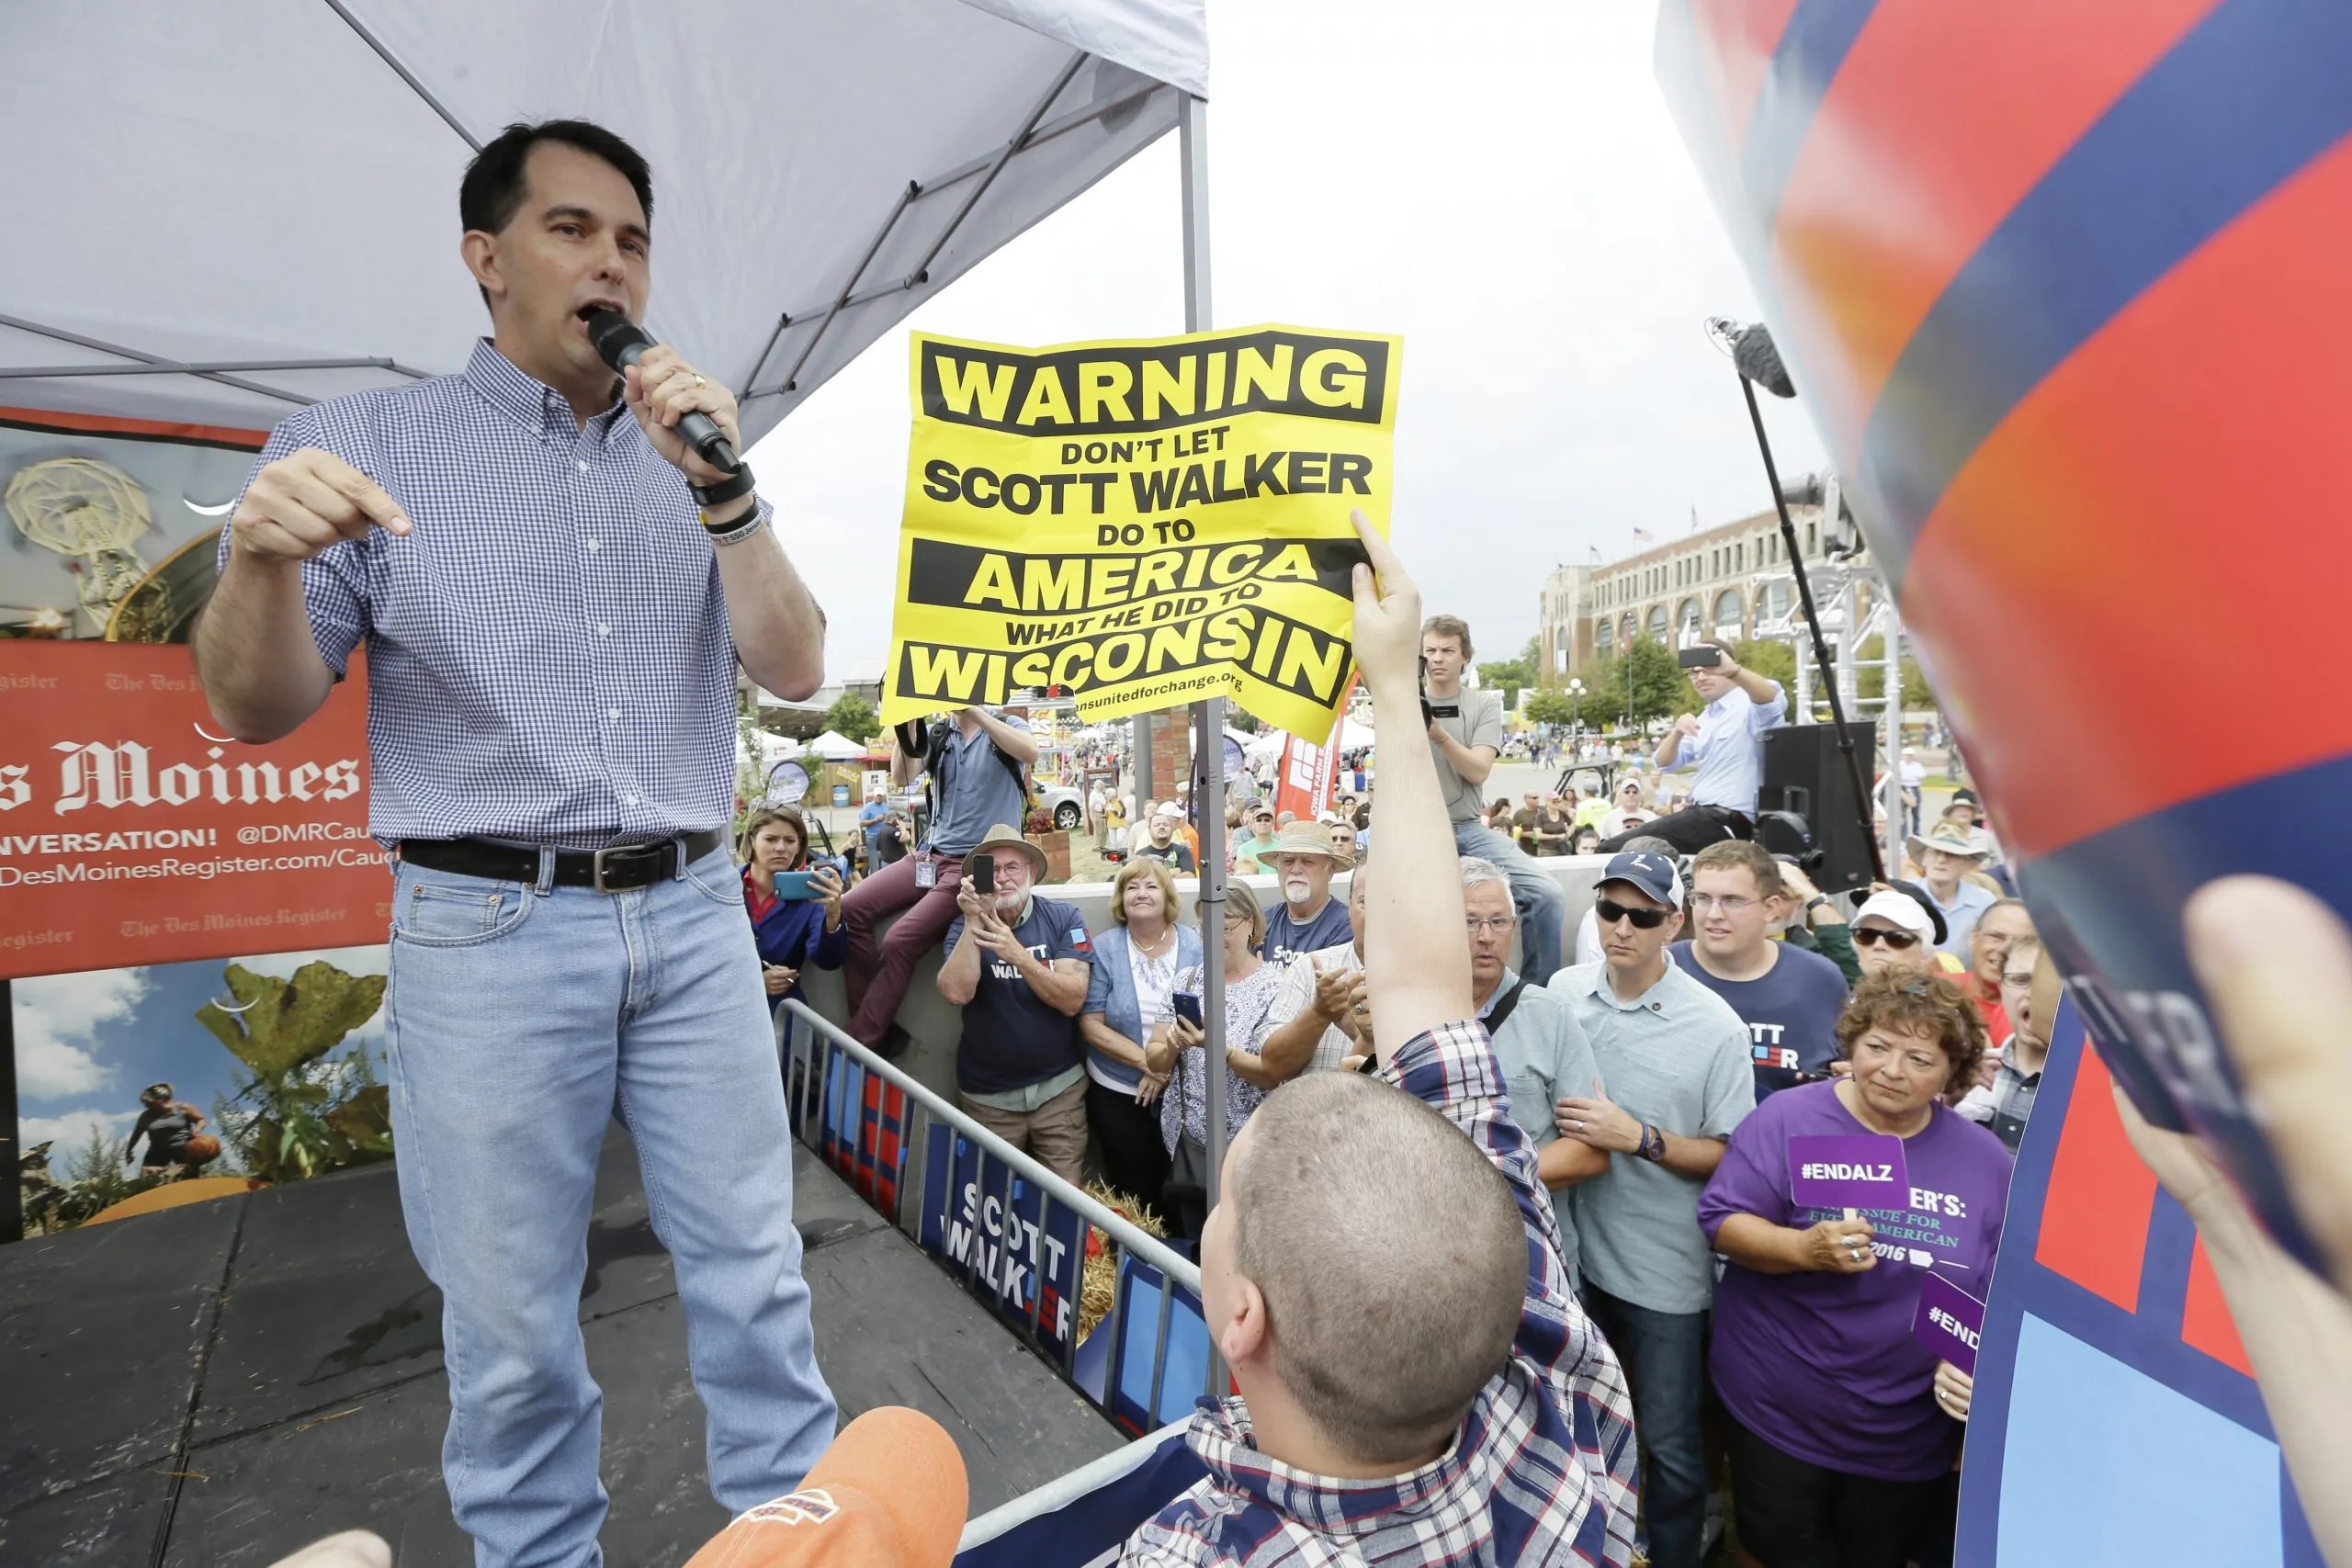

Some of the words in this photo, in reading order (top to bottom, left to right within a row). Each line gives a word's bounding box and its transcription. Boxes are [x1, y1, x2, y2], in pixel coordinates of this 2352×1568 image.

[934, 344, 1368, 426] WARNING
[1061, 435, 1163, 465] DON'T
[1174, 425, 1229, 458] LET
[922, 460, 1118, 514] SCOTT
[1130, 451, 1373, 513] WALKER
[1098, 523, 1144, 546] DO
[1153, 518, 1195, 542] TO
[963, 543, 1318, 611] AMERICA
[1006, 616, 1095, 646] WHAT
[1100, 604, 1143, 629] HE
[1150, 595, 1210, 622] DID
[1219, 582, 1261, 606] TO
[909, 607, 1344, 705] WISCONSIN
[105, 672, 144, 691] The
[149, 673, 185, 691] Des
[51, 739, 360, 816] Moines
[1314, 757, 1325, 787] FARM
[1310, 789, 1321, 817] IOWA
[120, 920, 159, 938] The
[164, 917, 199, 933] Des
[202, 913, 274, 931] Moines
[276, 908, 348, 926] Register
[0, 930, 75, 950] egister
[1801, 1163, 1894, 1182] #ENDALZ
[962, 1182, 1067, 1282] SCOTT
[1869, 1222, 1961, 1249] AMERICAN
[1905, 1213, 1942, 1231] FOR
[1869, 1241, 1907, 1263] 2016
